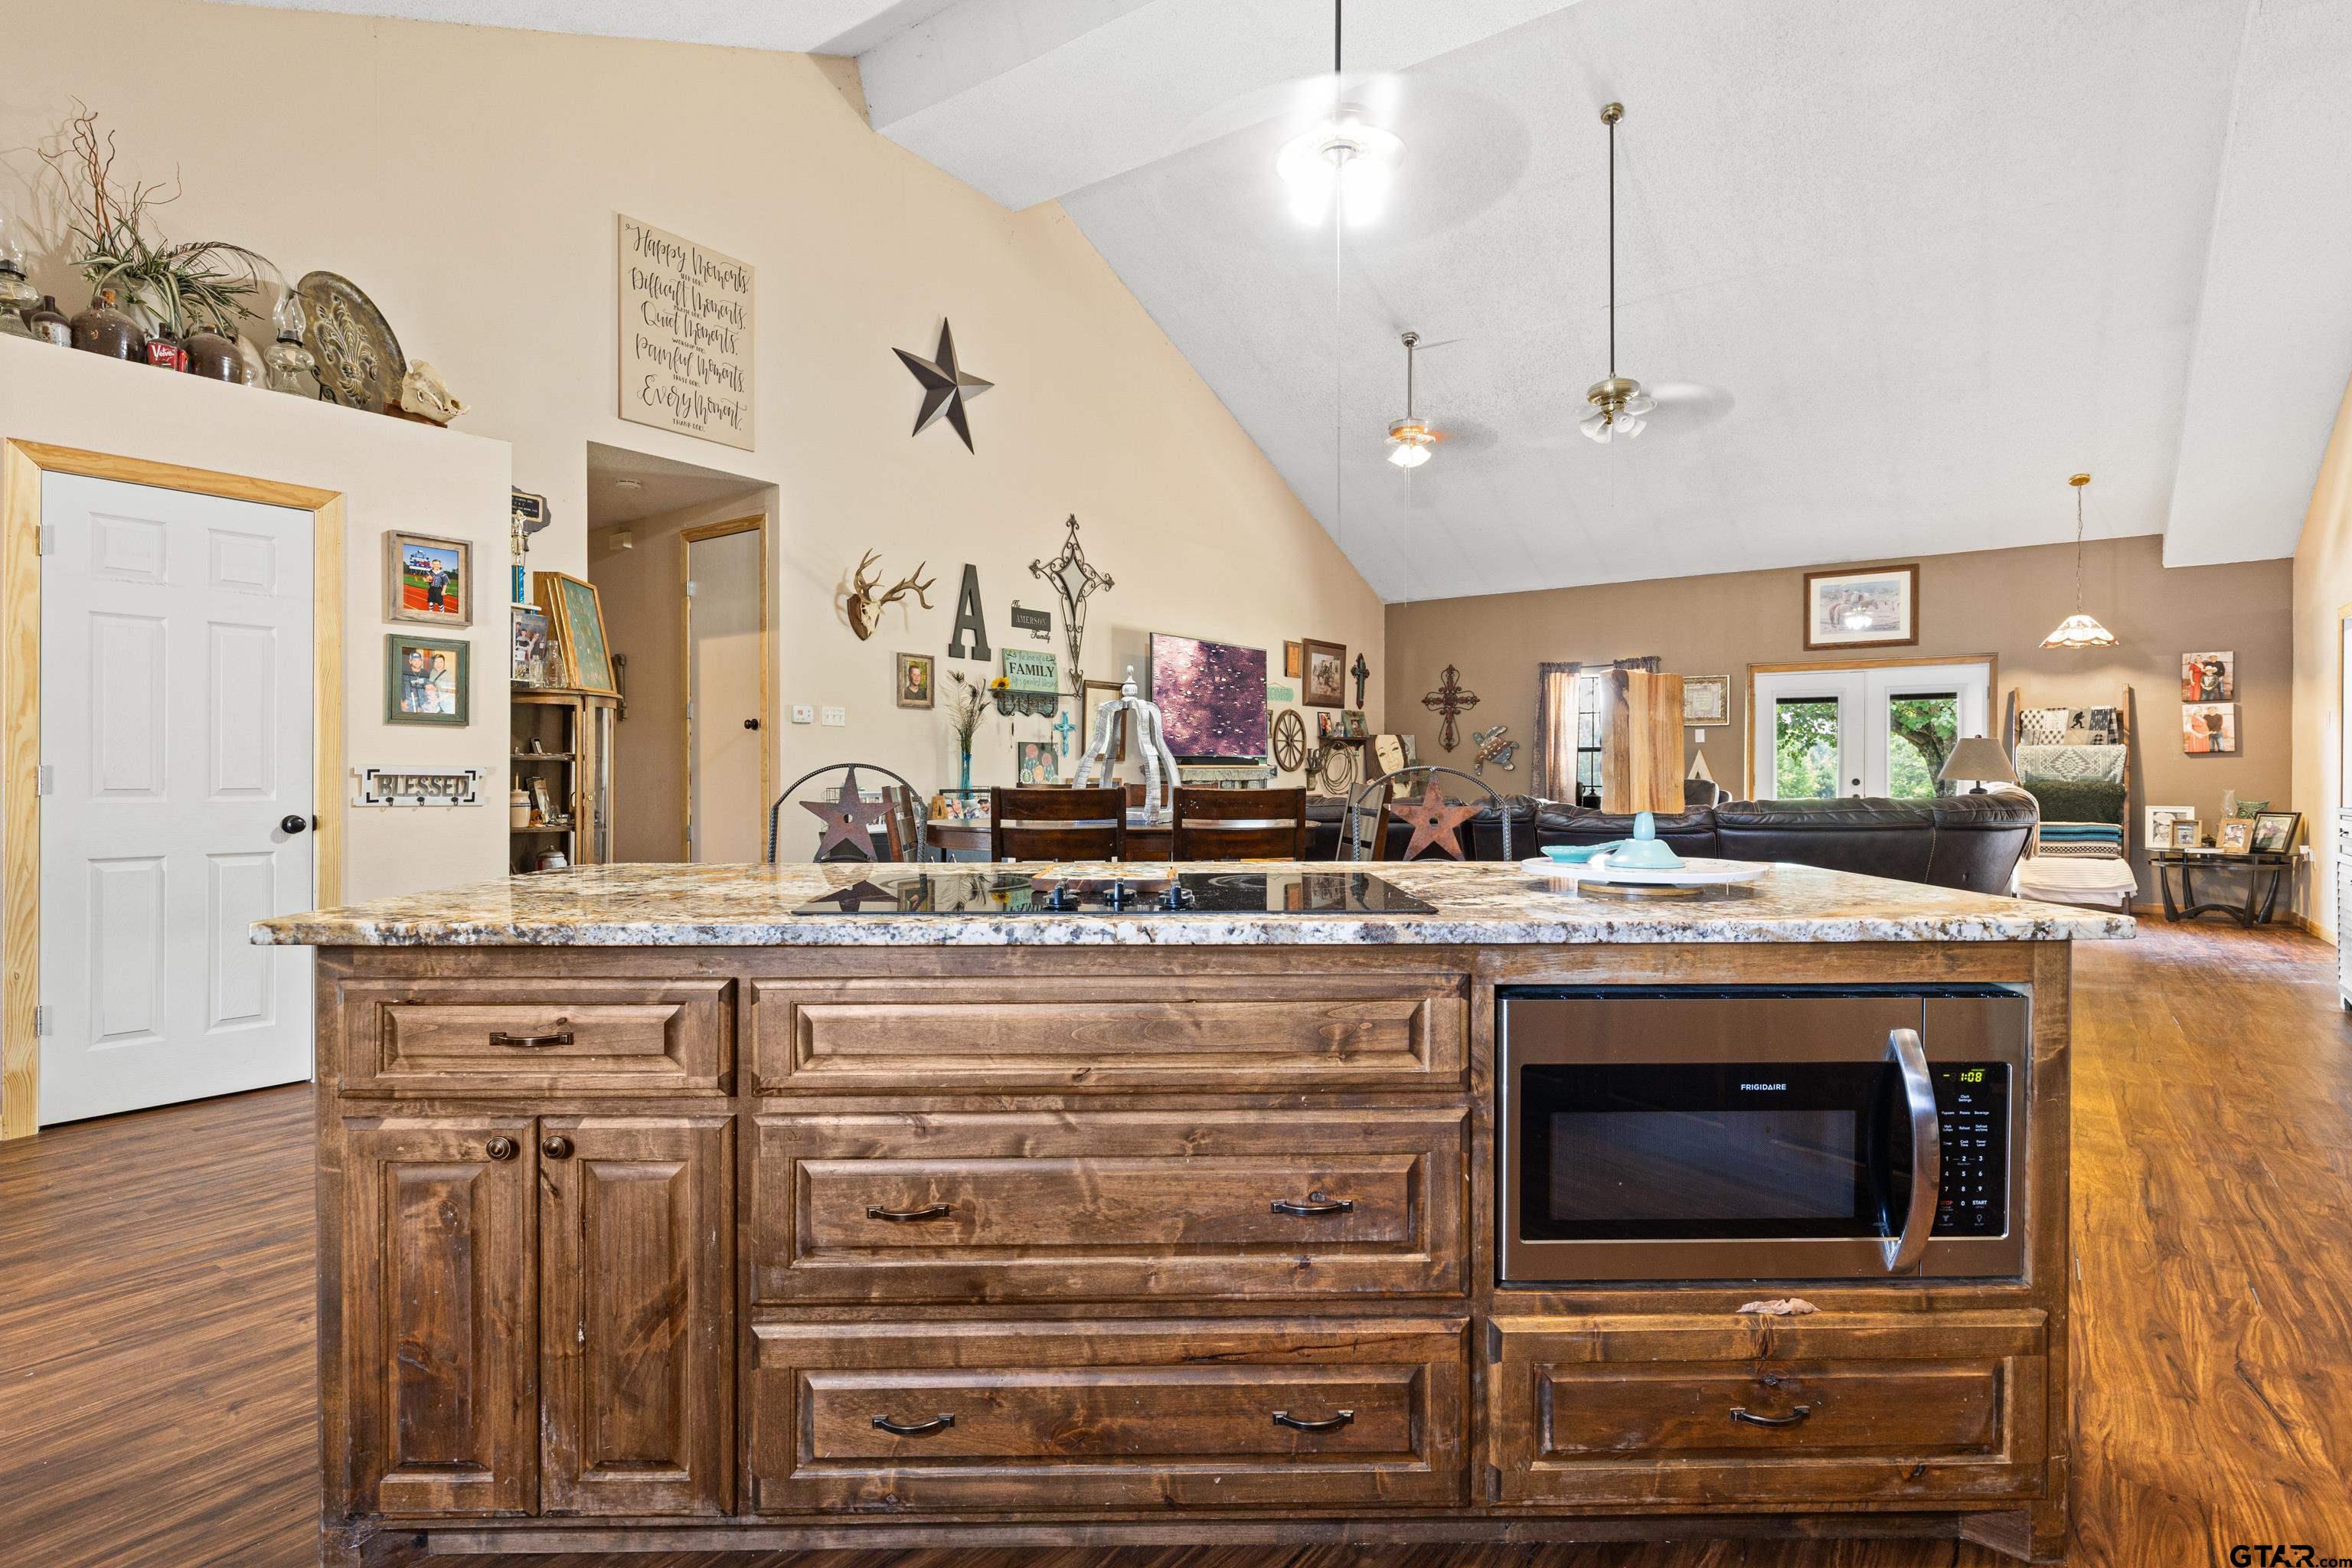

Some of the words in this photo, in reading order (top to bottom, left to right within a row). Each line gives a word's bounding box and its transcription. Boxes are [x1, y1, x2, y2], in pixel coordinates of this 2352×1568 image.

[625, 223, 687, 273] Happy
[629, 266, 689, 308] Difficult
[641, 300, 681, 335] Quiet
[671, 338, 695, 350] WORSHIP
[635, 333, 693, 377] Painful
[673, 374, 688, 384] TRUST
[637, 374, 691, 419] Every
[673, 418, 691, 429] THANK
[949, 564, 991, 662] A
[1016, 614, 1047, 626] AMERSON
[1031, 629, 1050, 643] Family
[1009, 662, 1054, 678] FAMILY
[378, 775, 469, 797] BLESSED
[1961, 1072, 1982, 1082] 1:08
